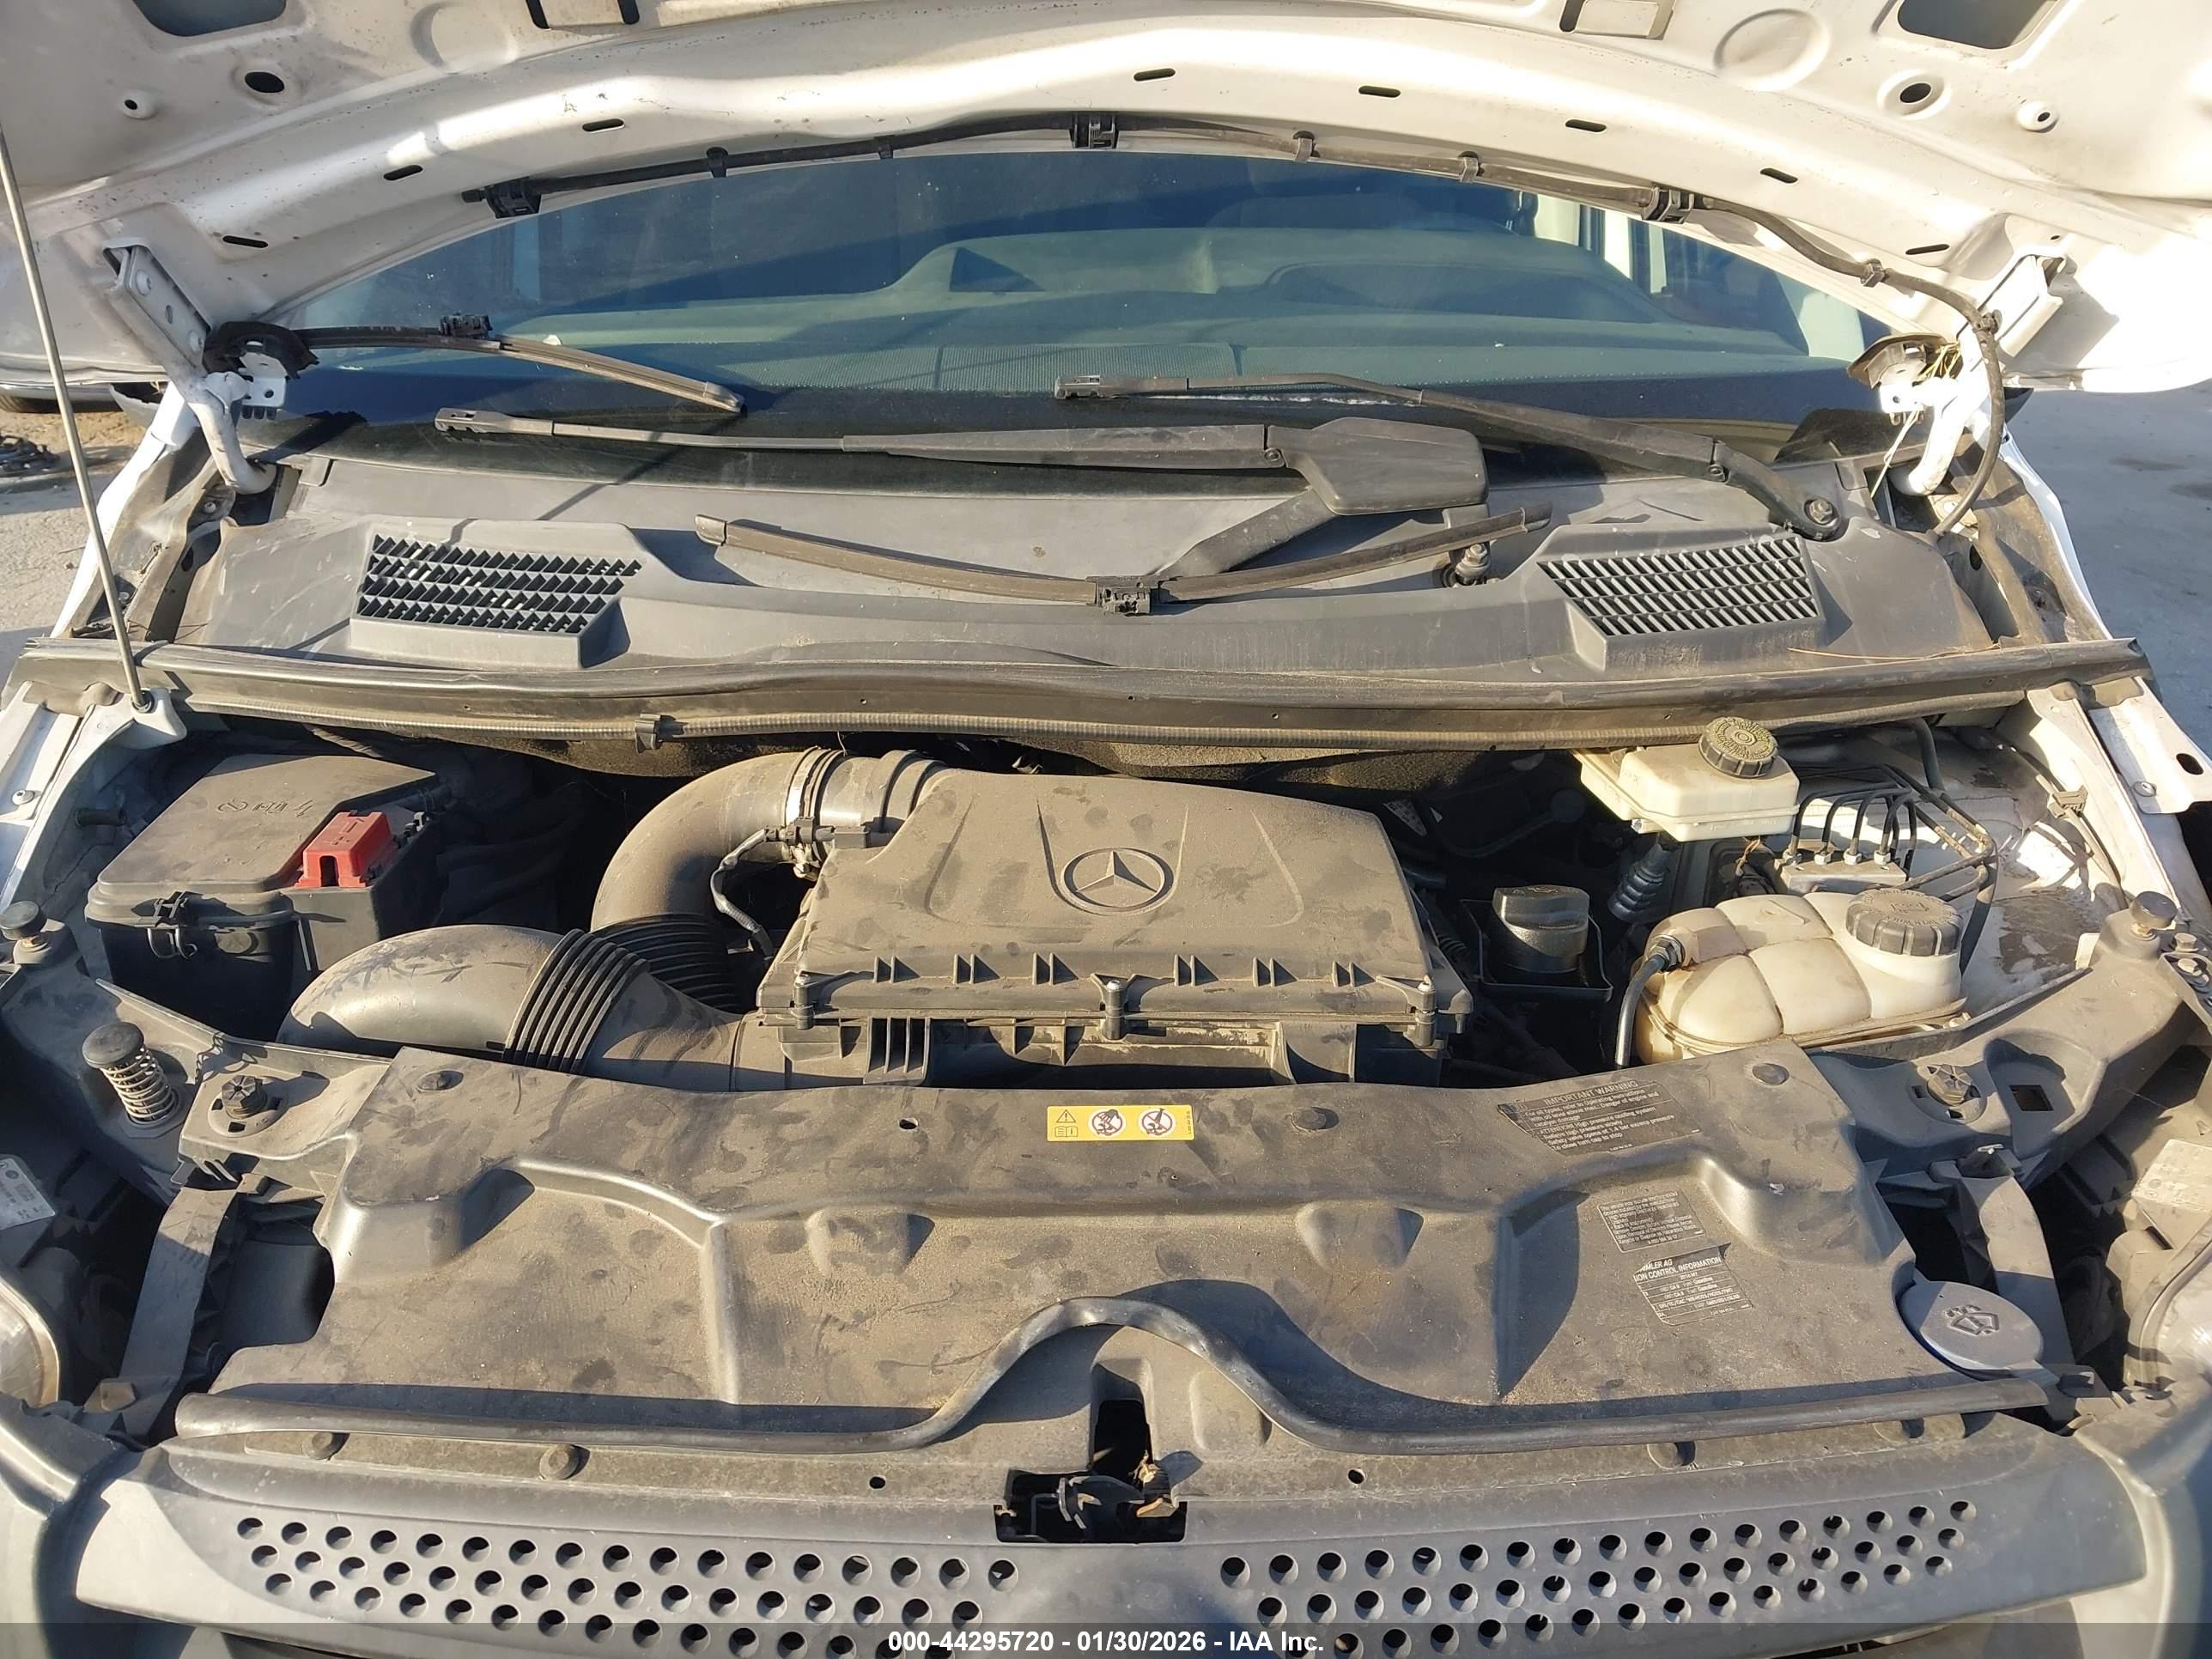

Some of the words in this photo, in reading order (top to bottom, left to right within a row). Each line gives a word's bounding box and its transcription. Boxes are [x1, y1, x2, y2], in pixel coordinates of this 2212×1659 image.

[1545, 1090, 1595, 1106] IMPORTANT
[1595, 1080, 1637, 1095] WARNING
[1649, 1267, 1678, 1279] CONTROL
[1679, 1256, 1722, 1272] INFORMATION
